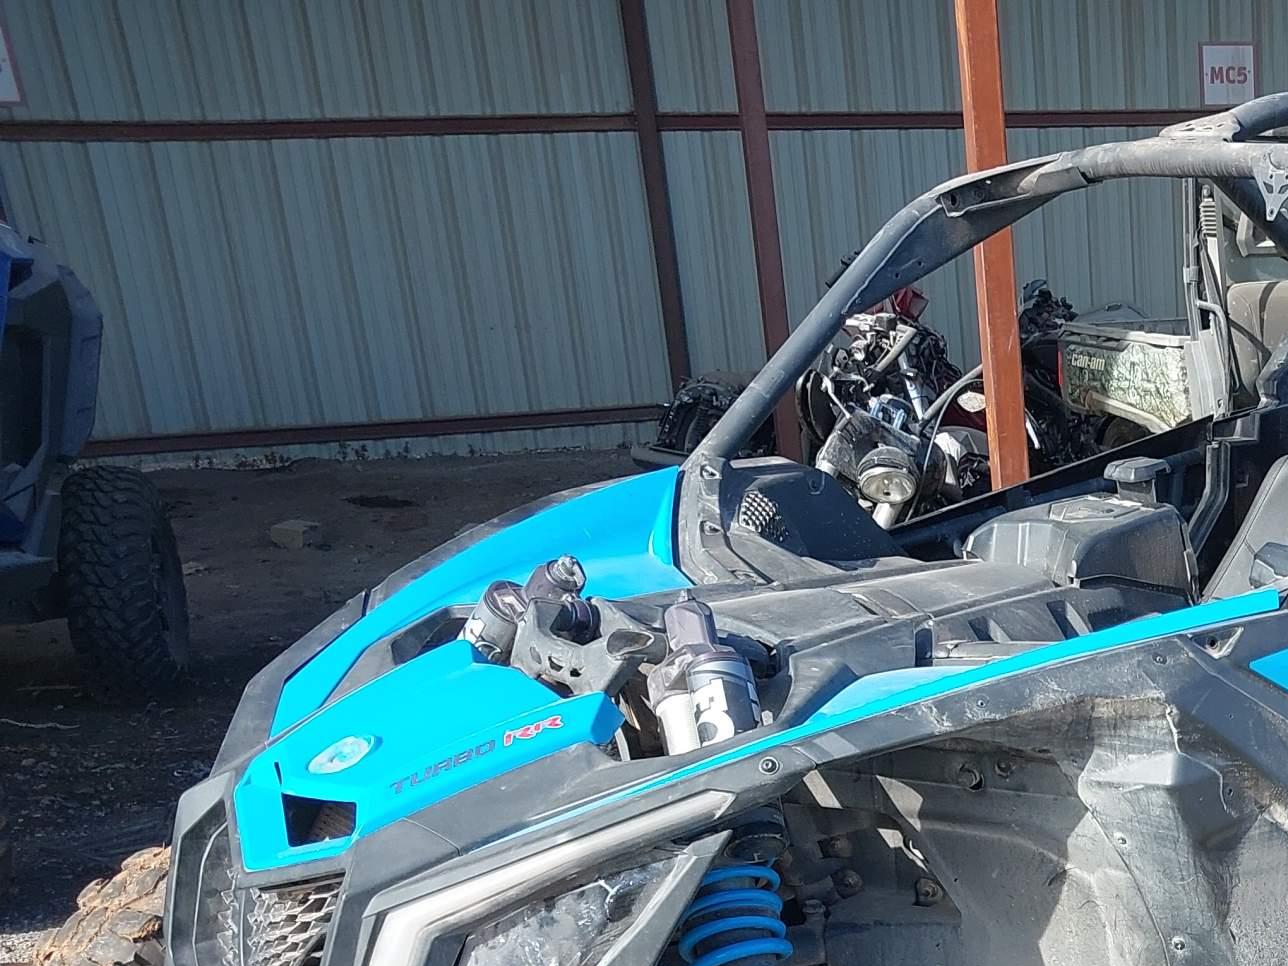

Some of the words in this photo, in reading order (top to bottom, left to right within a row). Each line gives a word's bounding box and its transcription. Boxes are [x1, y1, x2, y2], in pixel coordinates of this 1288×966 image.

[1210, 66, 1248, 84] MC5
[390, 739, 496, 795] TURBO
[503, 715, 565, 747] RR
